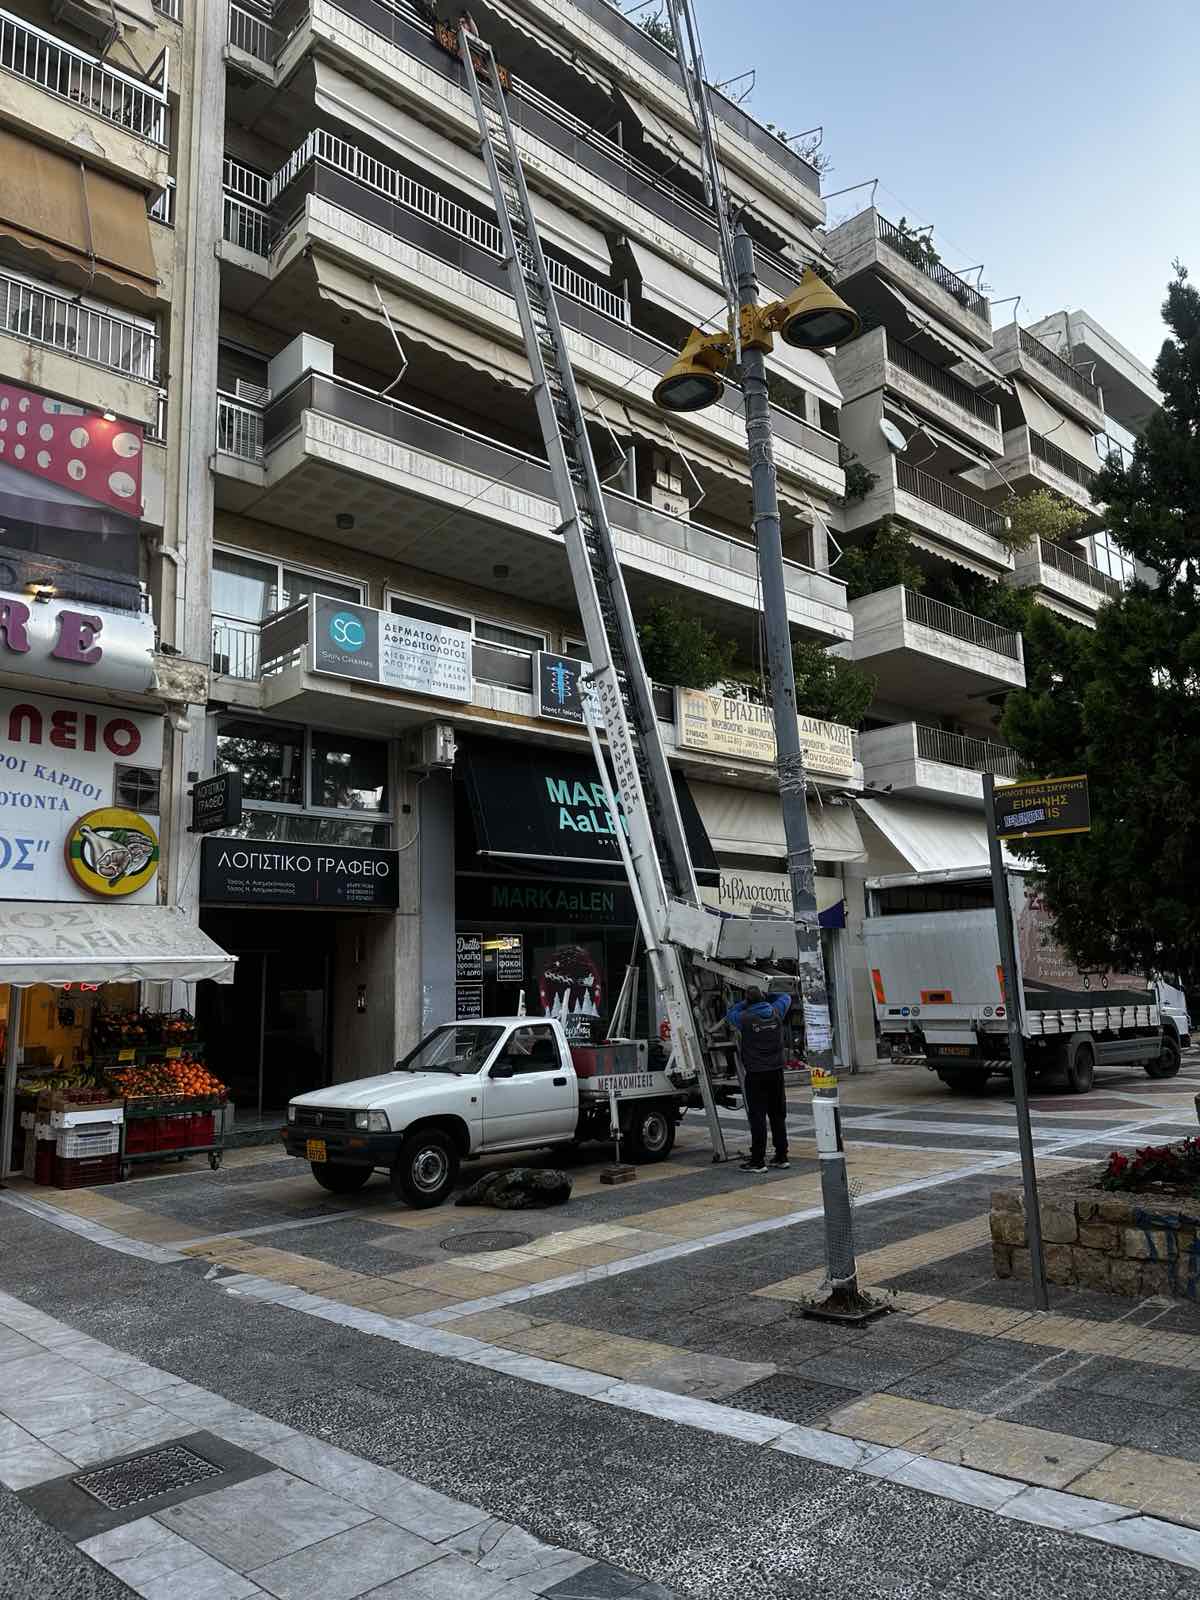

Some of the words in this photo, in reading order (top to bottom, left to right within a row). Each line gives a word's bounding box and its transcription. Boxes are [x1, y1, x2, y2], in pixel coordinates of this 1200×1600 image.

[333, 618, 363, 646] SC
[384, 623, 465, 649] ΔΕΡΜΑΤΟΛΟΓΟΣ
[384, 634, 465, 659] ΑΦΡΟΔΙΣΙΟΛΟΓΟΣ
[801, 719, 850, 746] ΔΙΑΓΝΩΣΗ
[34, 764, 103, 801] ΚΑΡΠΟΙ
[1013, 794, 1069, 810] ΕΙΡΗΝΗΣ
[217, 851, 312, 873] ΛΟΓΙΣΤΙΚΟ
[316, 857, 390, 877] ΓΡΑΦΕΙΟ
[598, 1075, 653, 1090] ΜΕΤΑΚΟΜΙΣΕΙΣ
